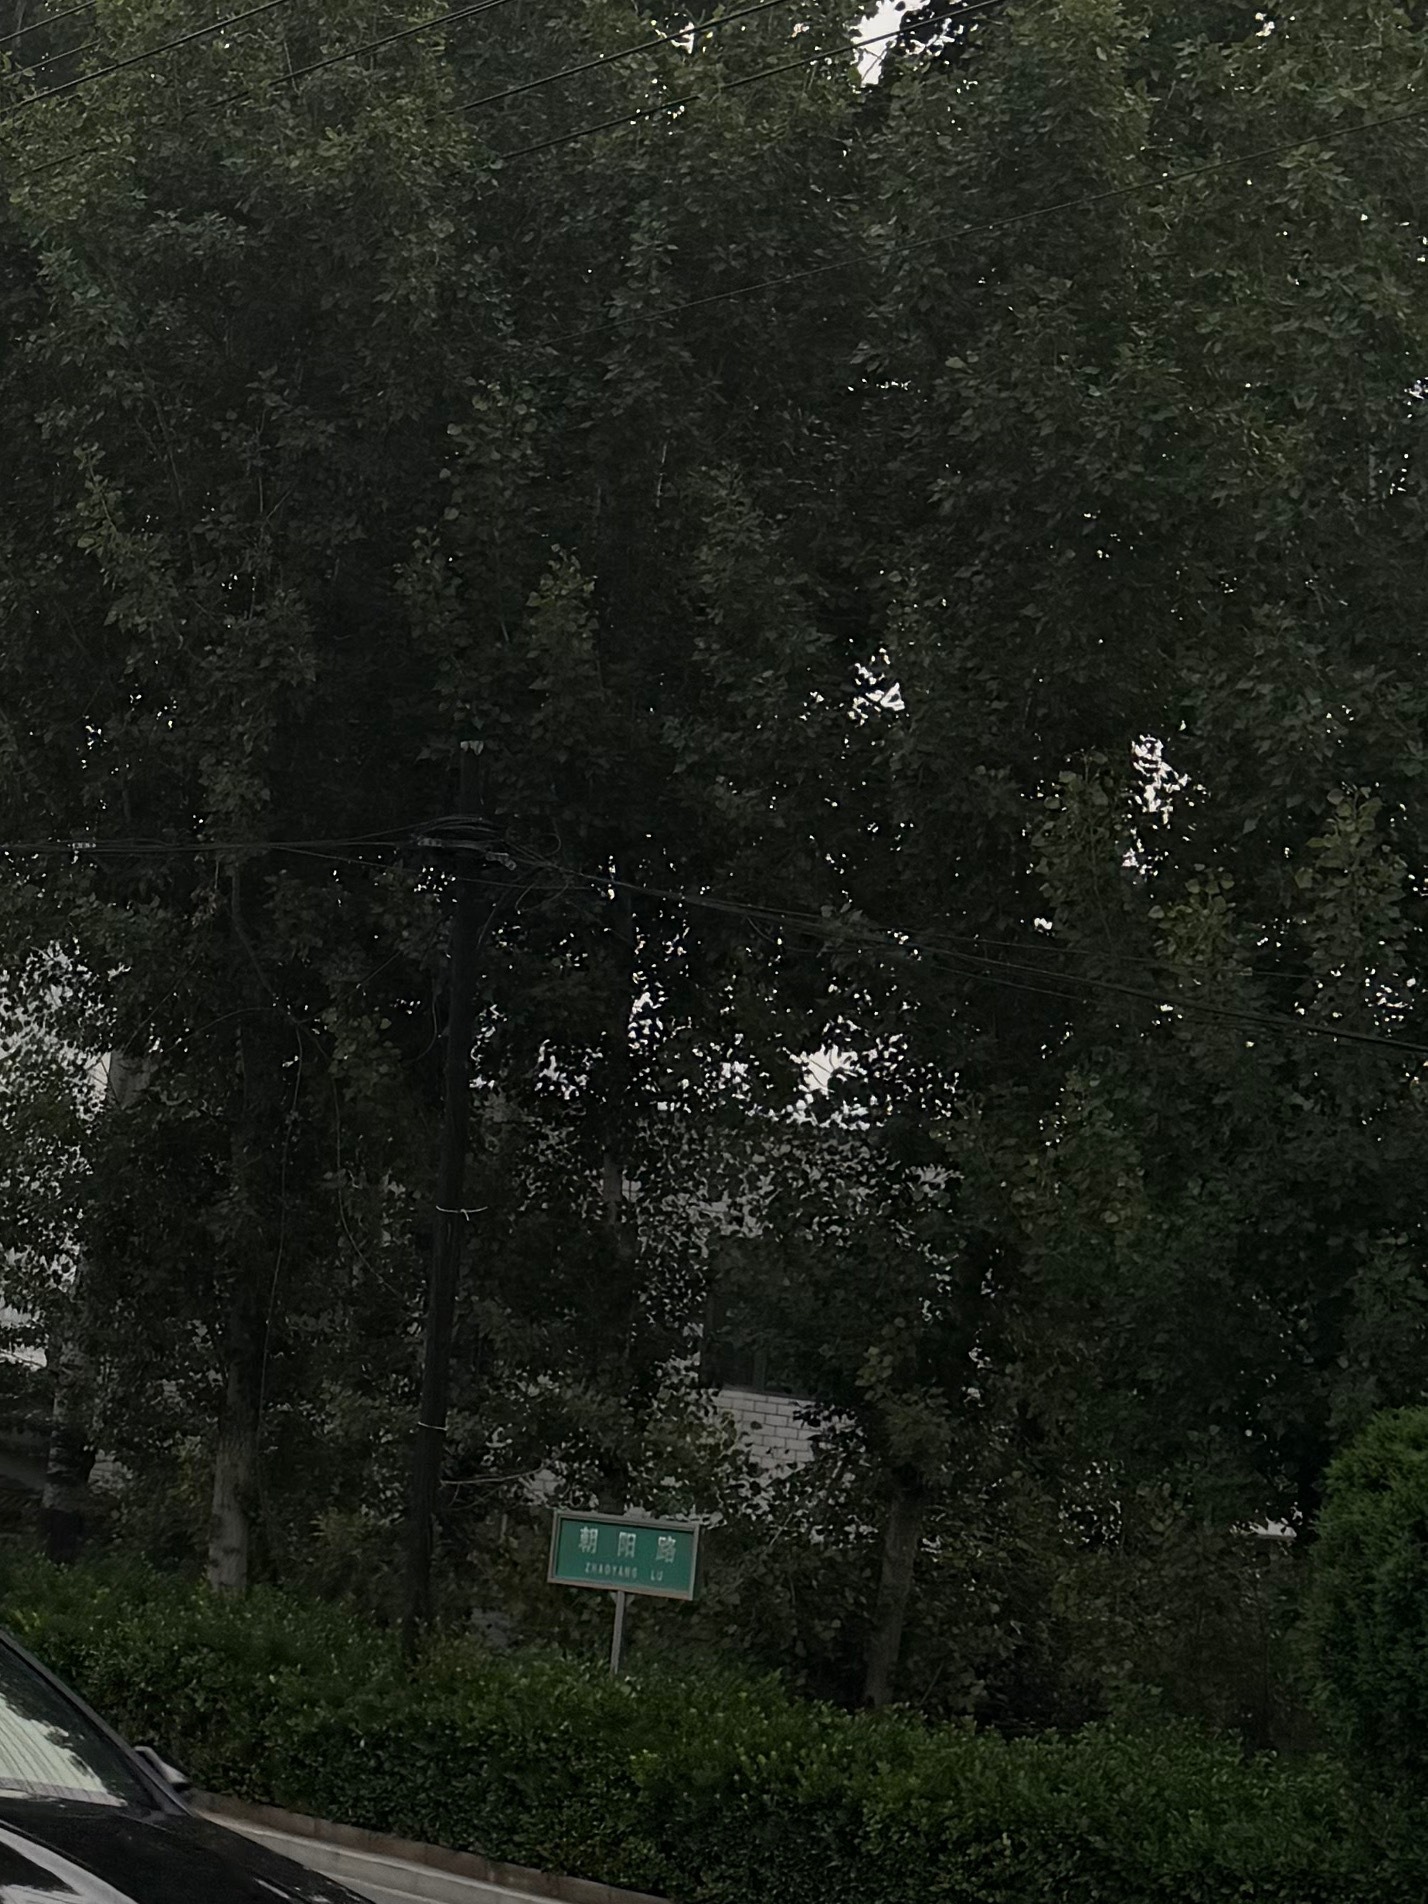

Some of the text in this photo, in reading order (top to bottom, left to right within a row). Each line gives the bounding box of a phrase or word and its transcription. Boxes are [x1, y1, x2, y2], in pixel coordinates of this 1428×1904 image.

[577, 1525, 677, 1563] 朝阳路
[584, 1561, 663, 1582] ZHAOYANG LU
